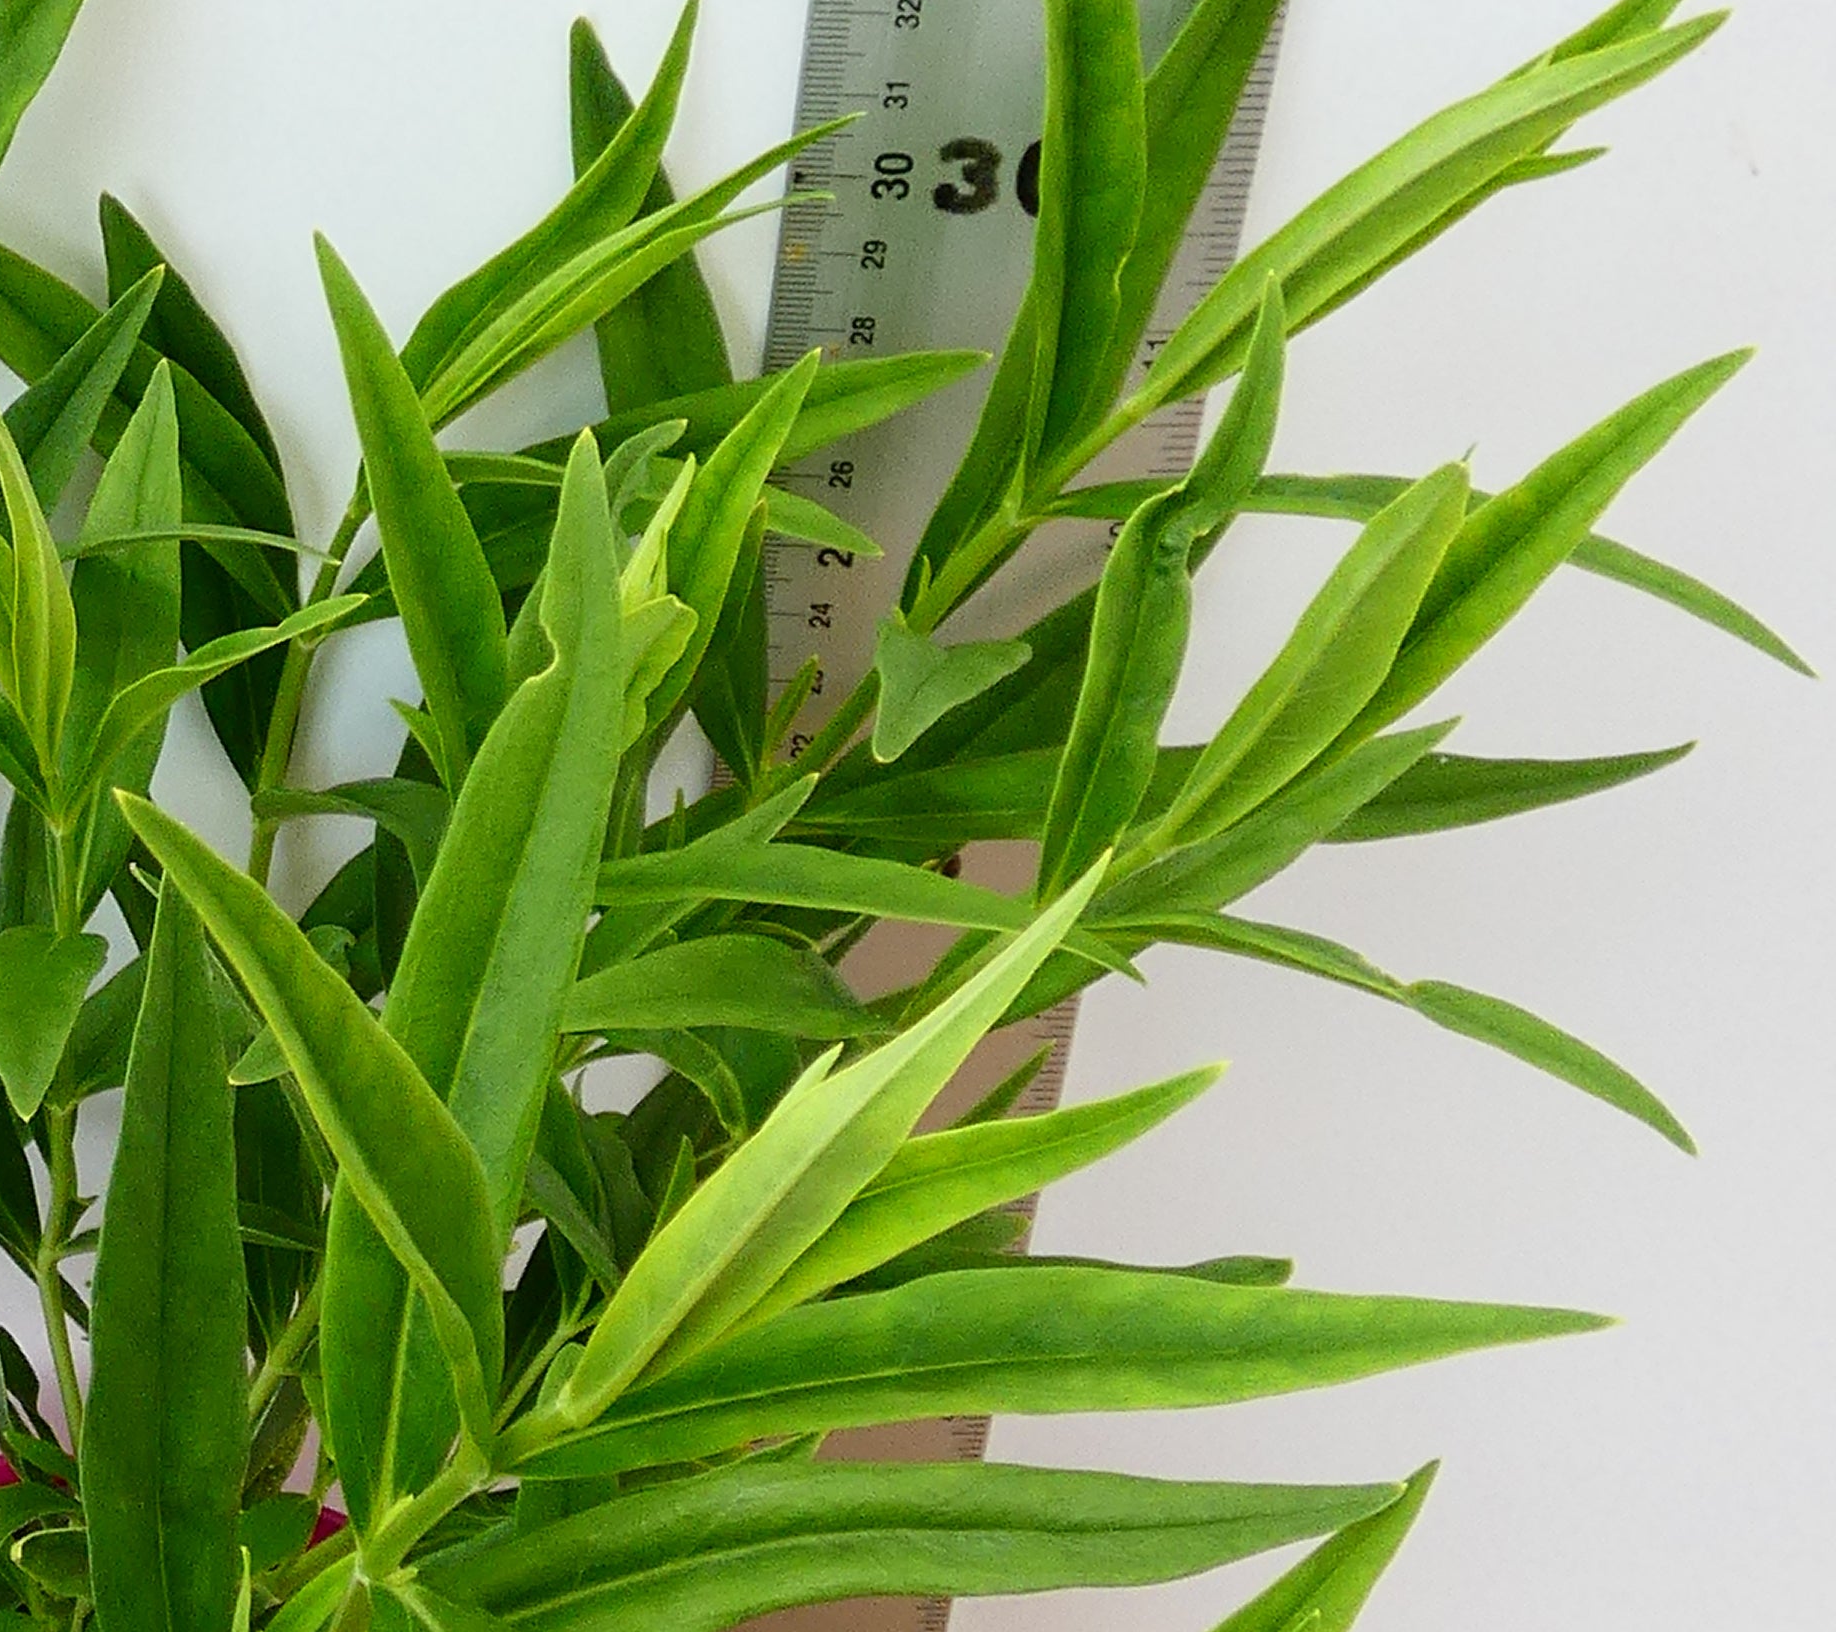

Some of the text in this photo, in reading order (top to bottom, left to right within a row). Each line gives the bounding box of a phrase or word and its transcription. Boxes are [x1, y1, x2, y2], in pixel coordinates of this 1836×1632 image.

[882, 82, 910, 110] 31
[870, 152, 914, 201] 30
[932, 135, 1042, 220] 3
[861, 239, 888, 270] 29
[848, 316, 876, 346] 28
[827, 460, 855, 489] 26
[807, 602, 833, 629] 24
